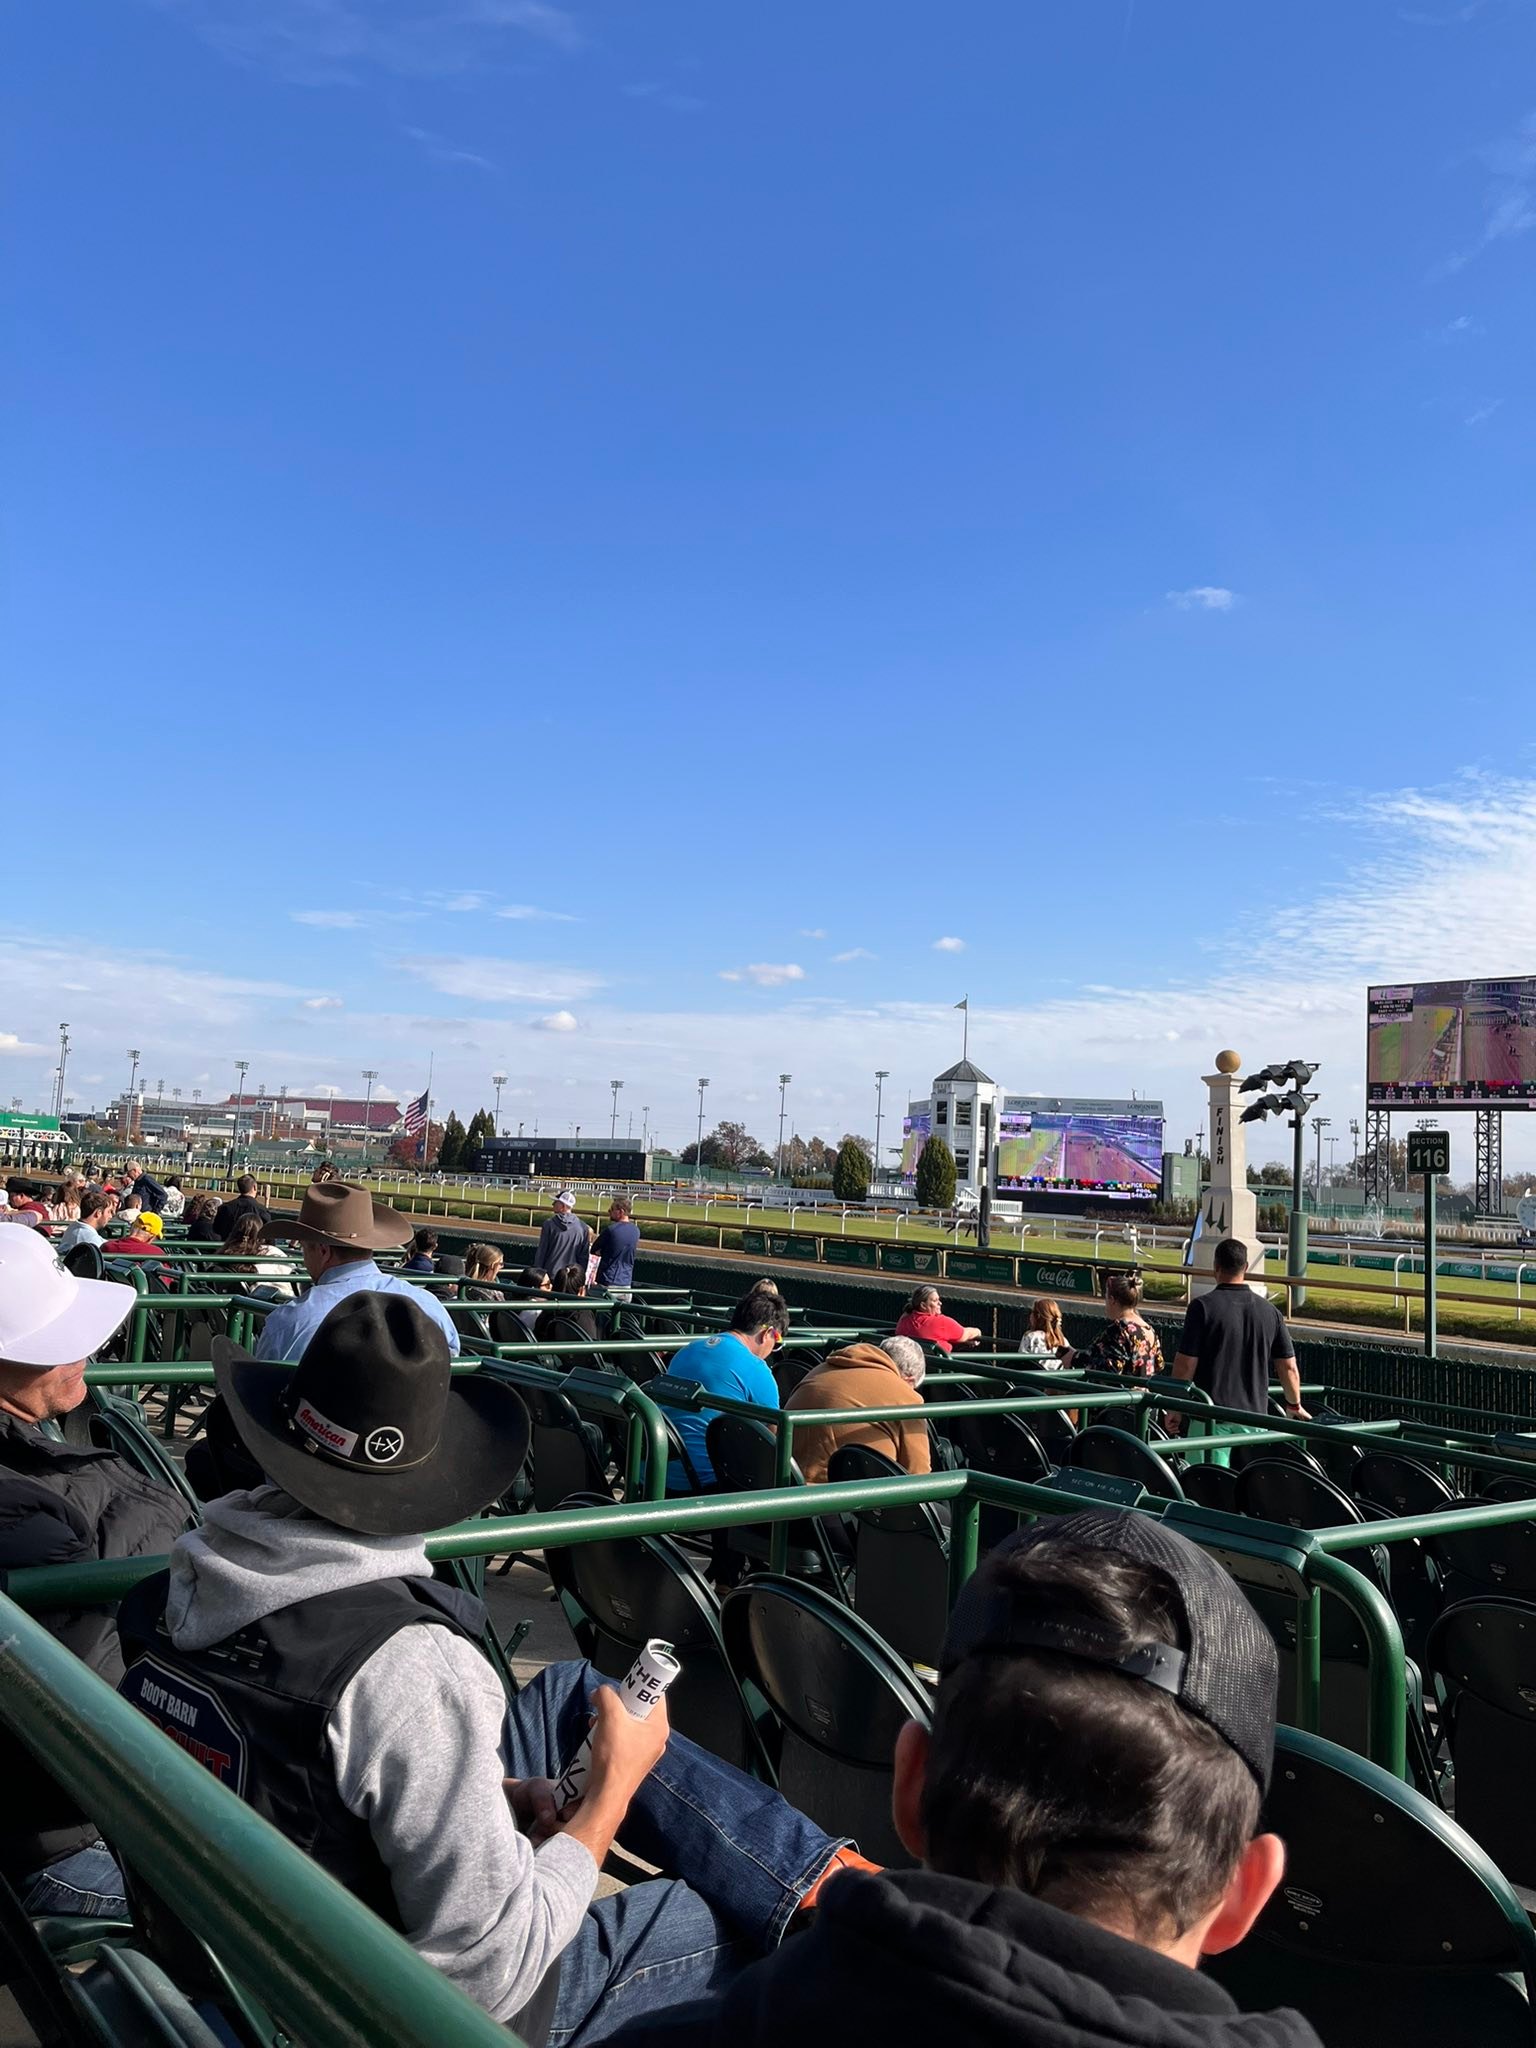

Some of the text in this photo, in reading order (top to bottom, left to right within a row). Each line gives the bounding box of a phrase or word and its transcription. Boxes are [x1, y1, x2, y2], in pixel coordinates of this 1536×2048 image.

[1216, 1107, 1224, 1165] FINISH
[1411, 1137, 1444, 1145] SECTION
[1412, 1148, 1446, 1168] 116
[300, 1408, 347, 1447] American
[140, 1676, 199, 1728] BOOT BARN
